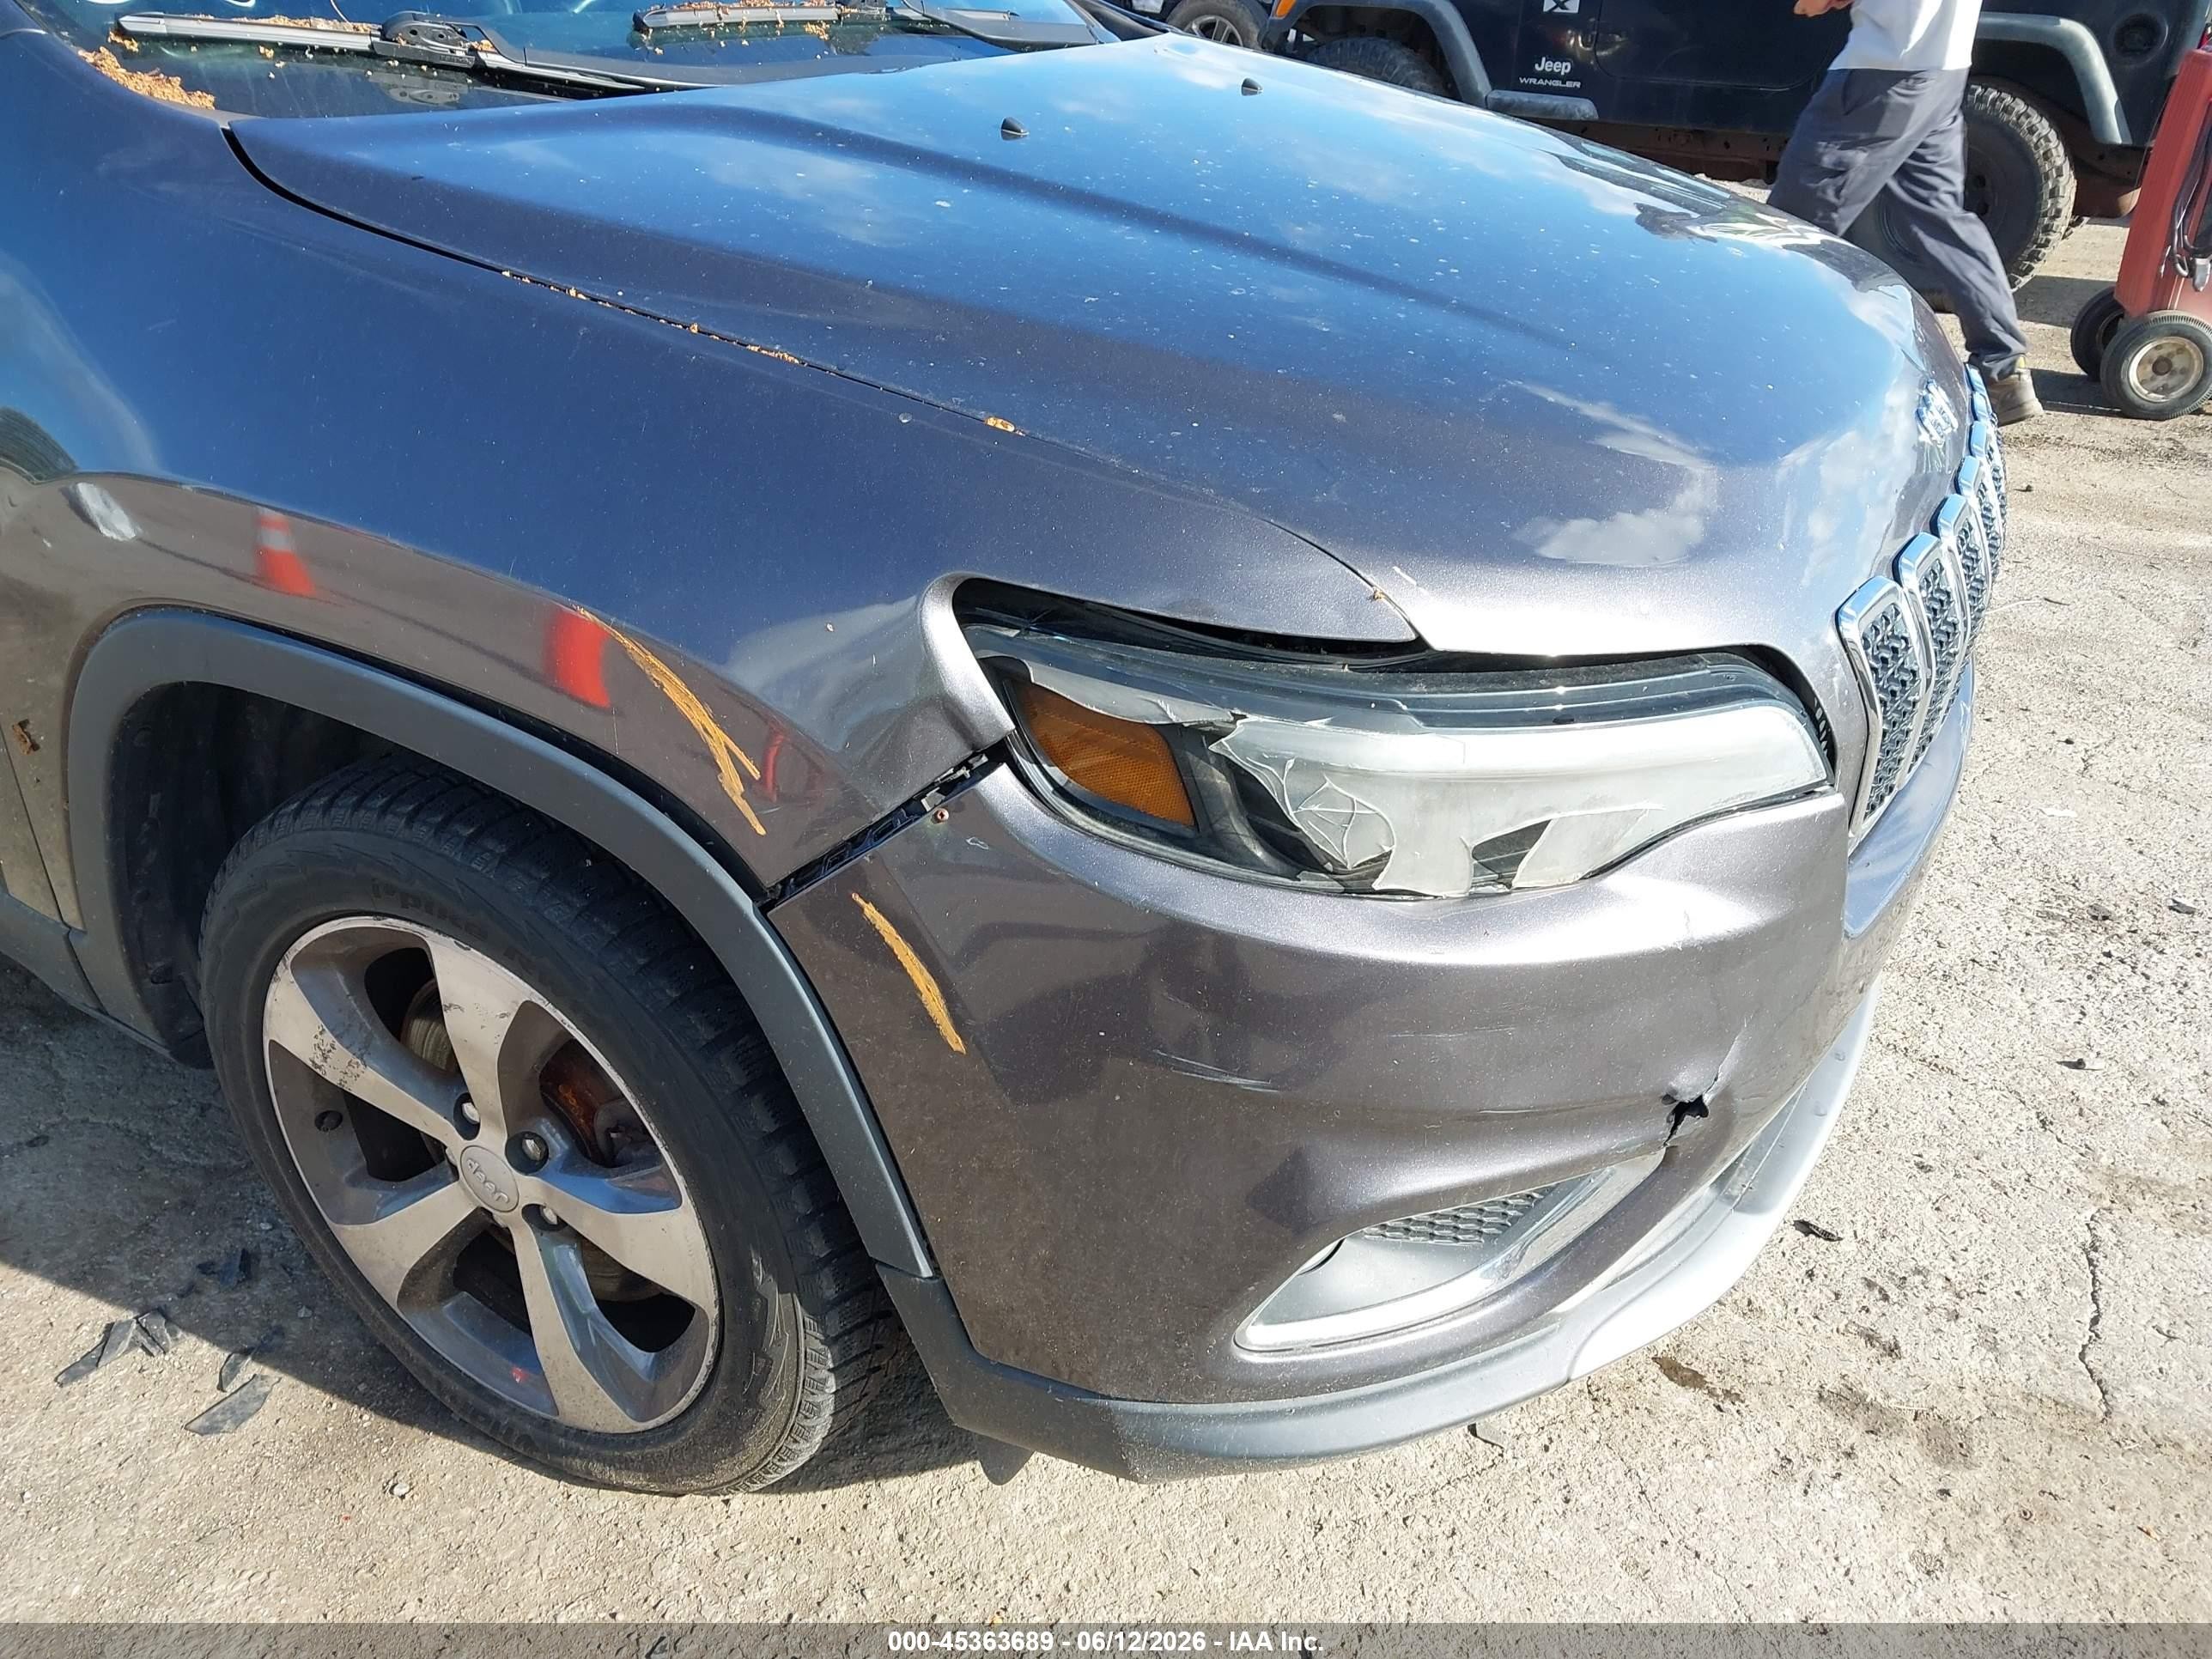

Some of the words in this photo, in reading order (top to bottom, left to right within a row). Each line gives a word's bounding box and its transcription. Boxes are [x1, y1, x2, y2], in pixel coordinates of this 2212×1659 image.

[1534, 56, 1571, 76] Jeep
[1518, 76, 1582, 88] WRANGLER
[465, 1158, 510, 1204] Jeep
